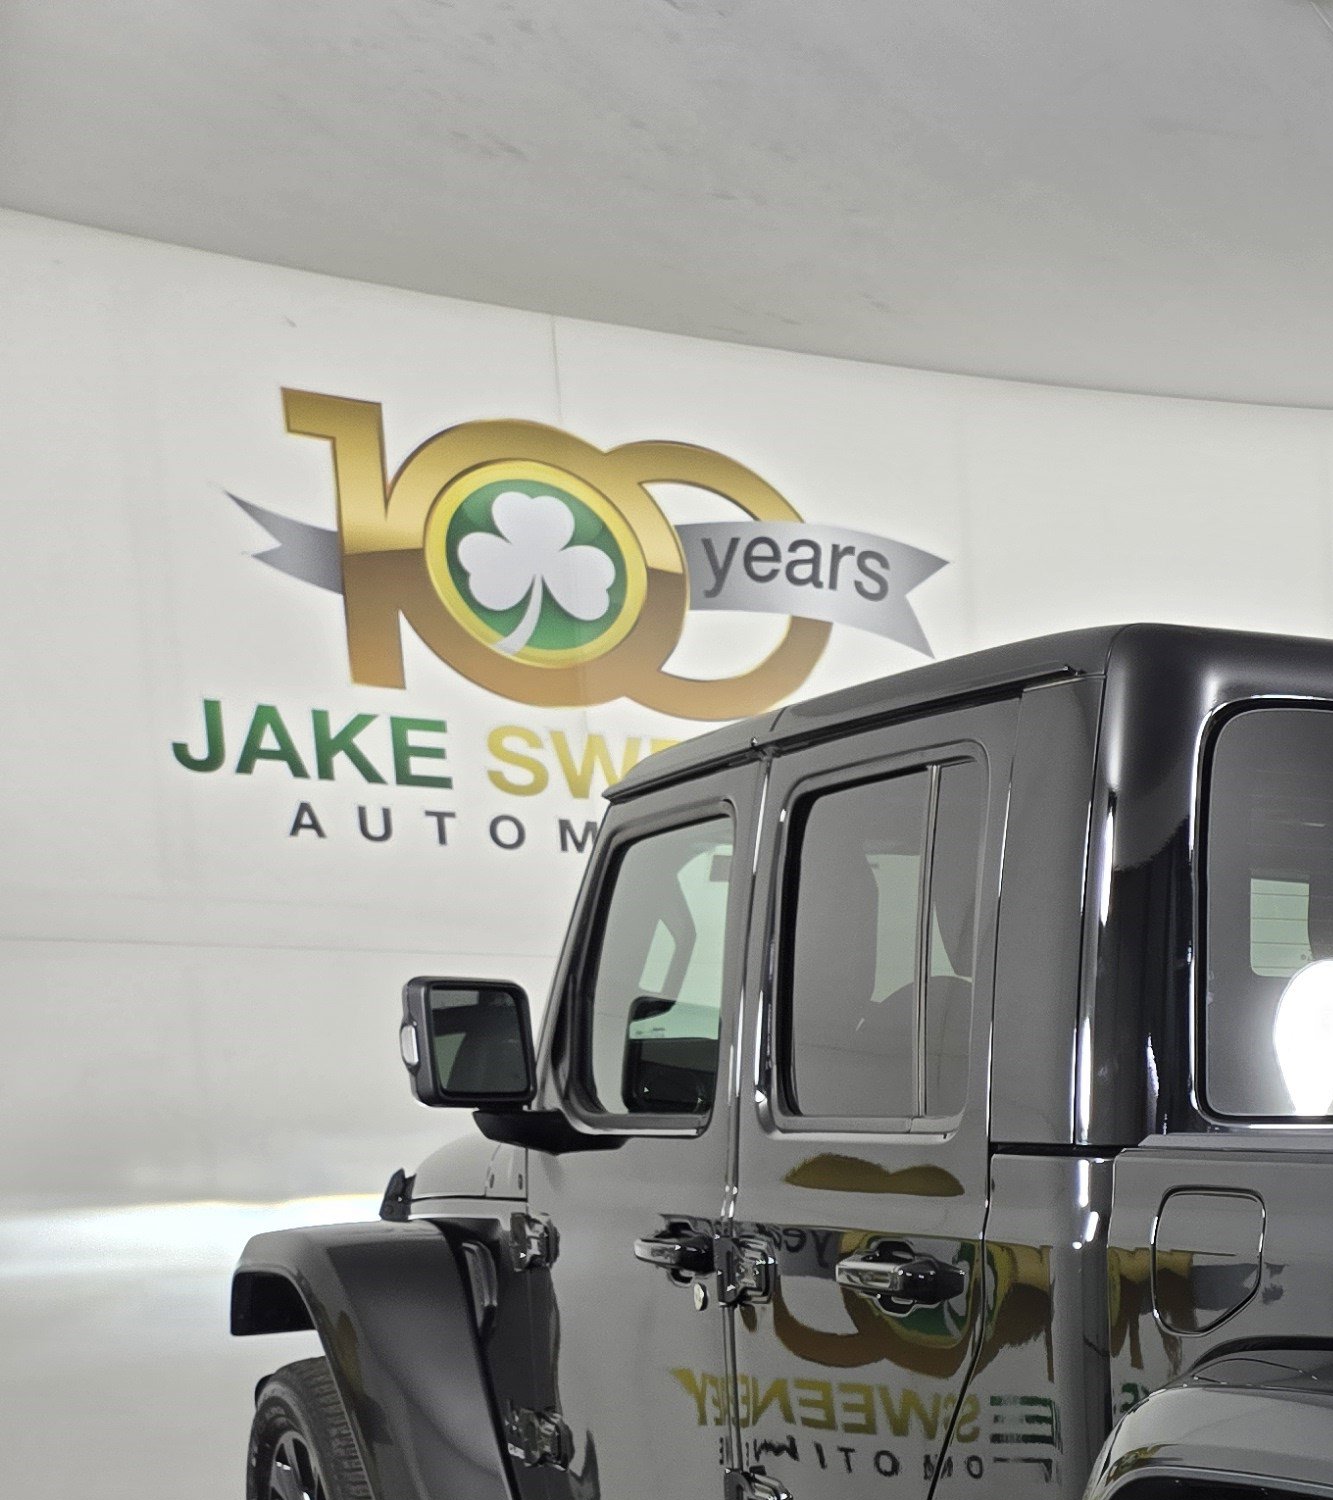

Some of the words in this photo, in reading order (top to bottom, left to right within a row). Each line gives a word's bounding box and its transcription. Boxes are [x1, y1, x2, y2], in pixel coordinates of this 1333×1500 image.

[281, 387, 834, 721] 100
[703, 535, 893, 602] years
[172, 698, 453, 790] JAKE
